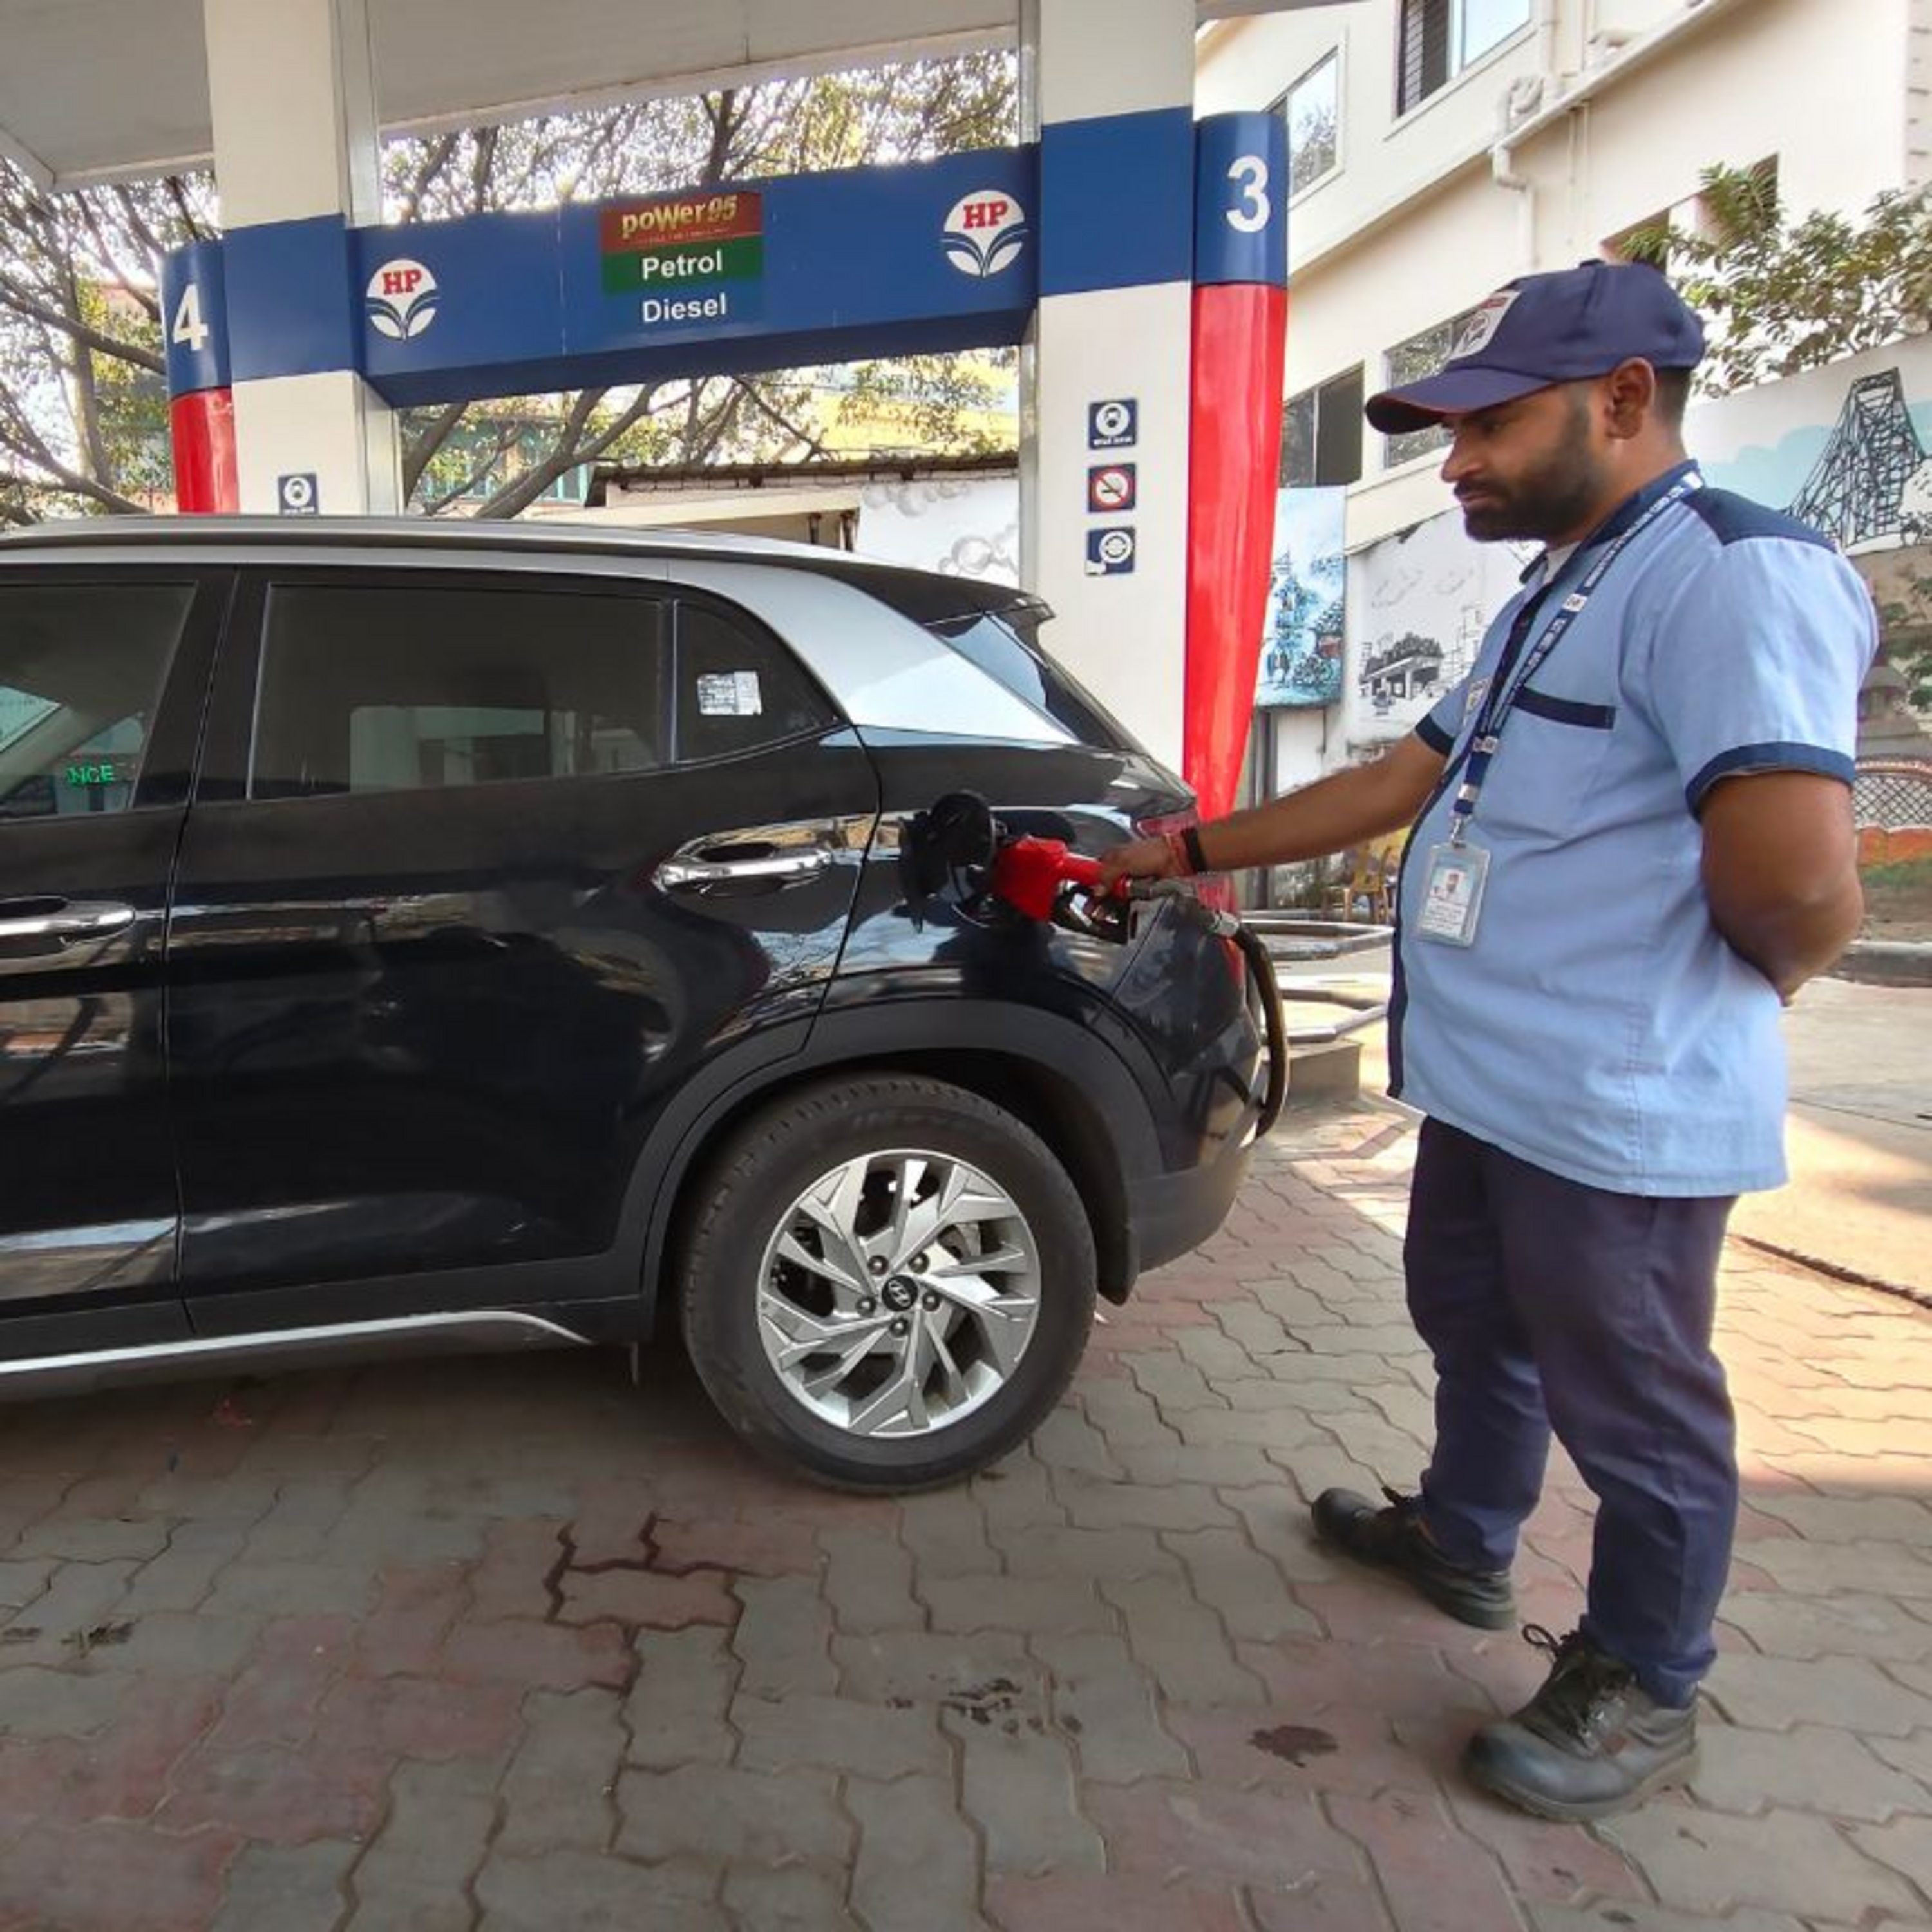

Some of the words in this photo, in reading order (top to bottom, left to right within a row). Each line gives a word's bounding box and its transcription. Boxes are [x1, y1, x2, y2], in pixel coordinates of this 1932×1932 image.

[1227, 155, 1271, 232] 3
[963, 200, 1008, 229] HP
[642, 249, 723, 281] Petrol
[383, 269, 422, 295] HP
[173, 283, 208, 350] 4
[642, 292, 726, 323] Diesel
